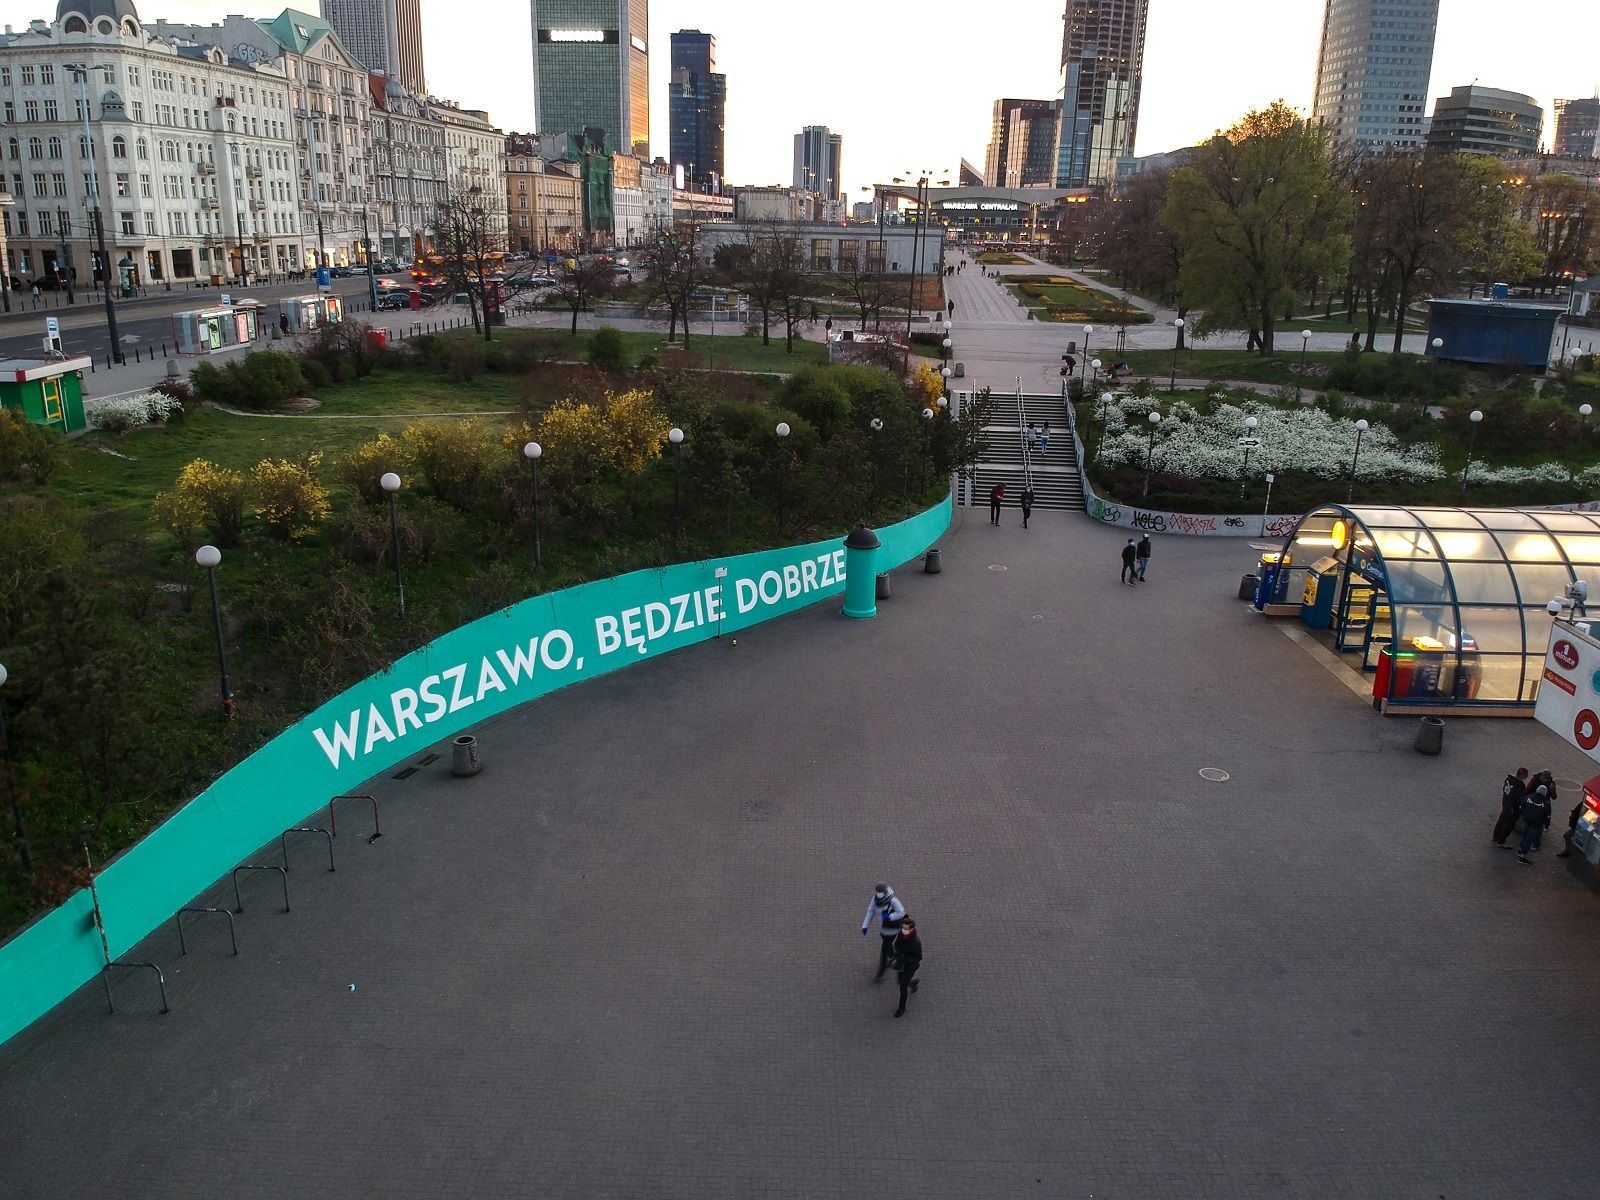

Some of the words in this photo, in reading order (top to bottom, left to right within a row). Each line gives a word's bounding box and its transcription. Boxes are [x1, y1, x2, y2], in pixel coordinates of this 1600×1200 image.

[312, 629, 584, 770] WARSZAWO,
[595, 585, 726, 654] BĘDZIE
[735, 549, 847, 614] DOBRZE
